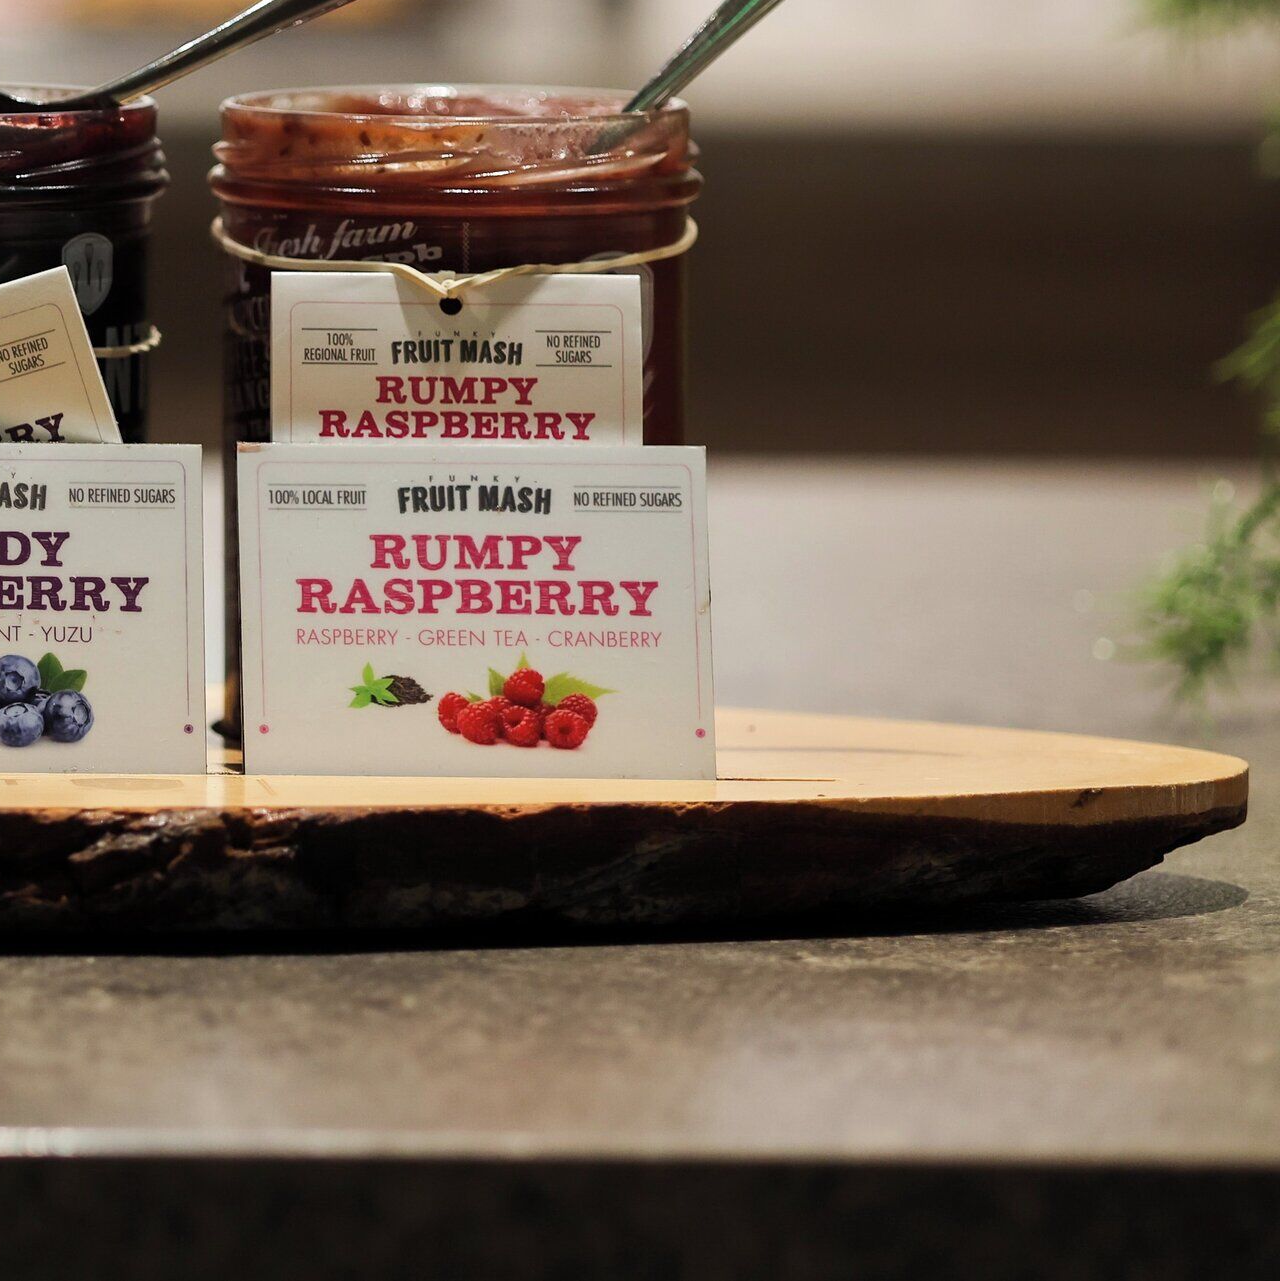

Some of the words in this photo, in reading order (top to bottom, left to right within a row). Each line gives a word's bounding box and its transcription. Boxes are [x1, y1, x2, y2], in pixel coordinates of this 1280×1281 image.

[11, 337, 48, 358] REFINED
[326, 333, 354, 346] 100%
[546, 335, 560, 348] NO
[563, 335, 601, 349] REFINED
[304, 348, 347, 362] REGIONAL
[350, 348, 376, 362] FRUIT
[391, 339, 455, 365] FRUIT
[460, 340, 523, 366] MASH
[555, 350, 593, 364] SUGARS
[9, 354, 45, 375] SUGARS
[375, 376, 538, 406] RUMPY
[318, 410, 596, 441] RASPBERRY
[429, 474, 522, 483] FUNKY
[69, 488, 85, 503] NO
[88, 488, 130, 504] REFINED
[134, 488, 176, 504] SUGARS
[268, 490, 299, 505] 100%
[302, 490, 334, 505] LOCAL
[337, 490, 367, 506] FRUIT
[397, 484, 473, 515] FRUIT
[478, 485, 552, 515] MASH
[573, 492, 590, 507] NO
[593, 492, 637, 508] REFINED
[639, 492, 683, 508] SUGARS
[369, 534, 582, 571] RUMPY
[295, 578, 659, 617] RASPBERRY
[43, 626, 93, 644] YUZU
[296, 627, 398, 646] RASPBERRY
[417, 628, 486, 647] GREEN
[493, 629, 529, 647] TEA
[547, 630, 662, 648] CRANBERRY
